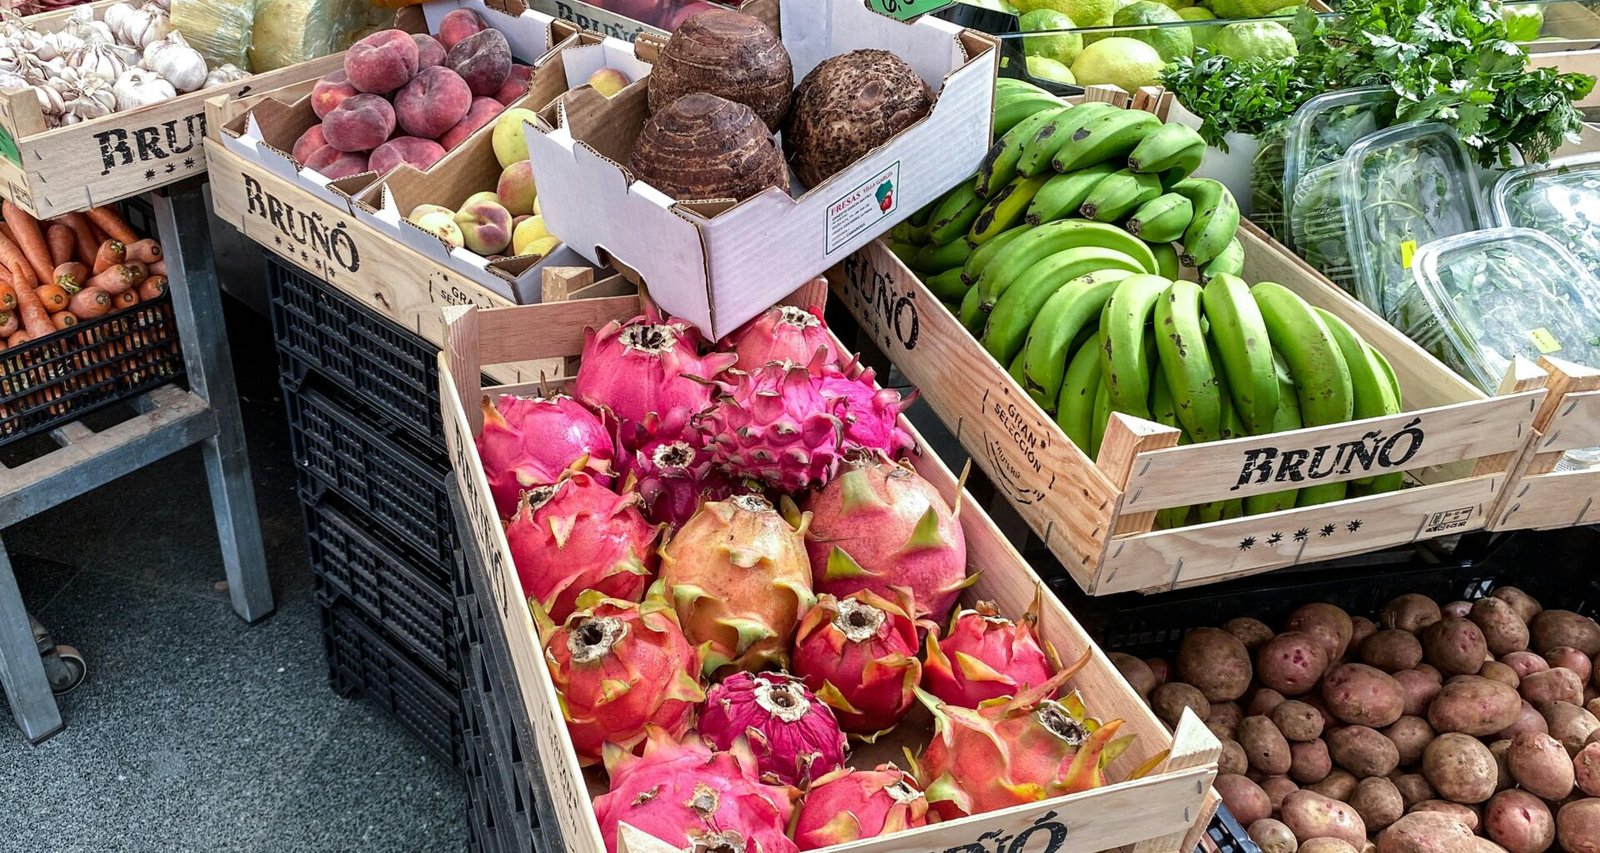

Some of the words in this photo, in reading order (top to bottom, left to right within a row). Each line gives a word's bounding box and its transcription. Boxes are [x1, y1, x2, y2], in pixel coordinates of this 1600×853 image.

[241, 171, 360, 273] BRUÑÓ
[831, 192, 861, 216] FRESAS
[451, 286, 480, 310] GRA
[994, 402, 1042, 474] SELECCIÓN
[1008, 403, 1037, 449] GRAN
[1230, 417, 1424, 491] BRUÑÓ
